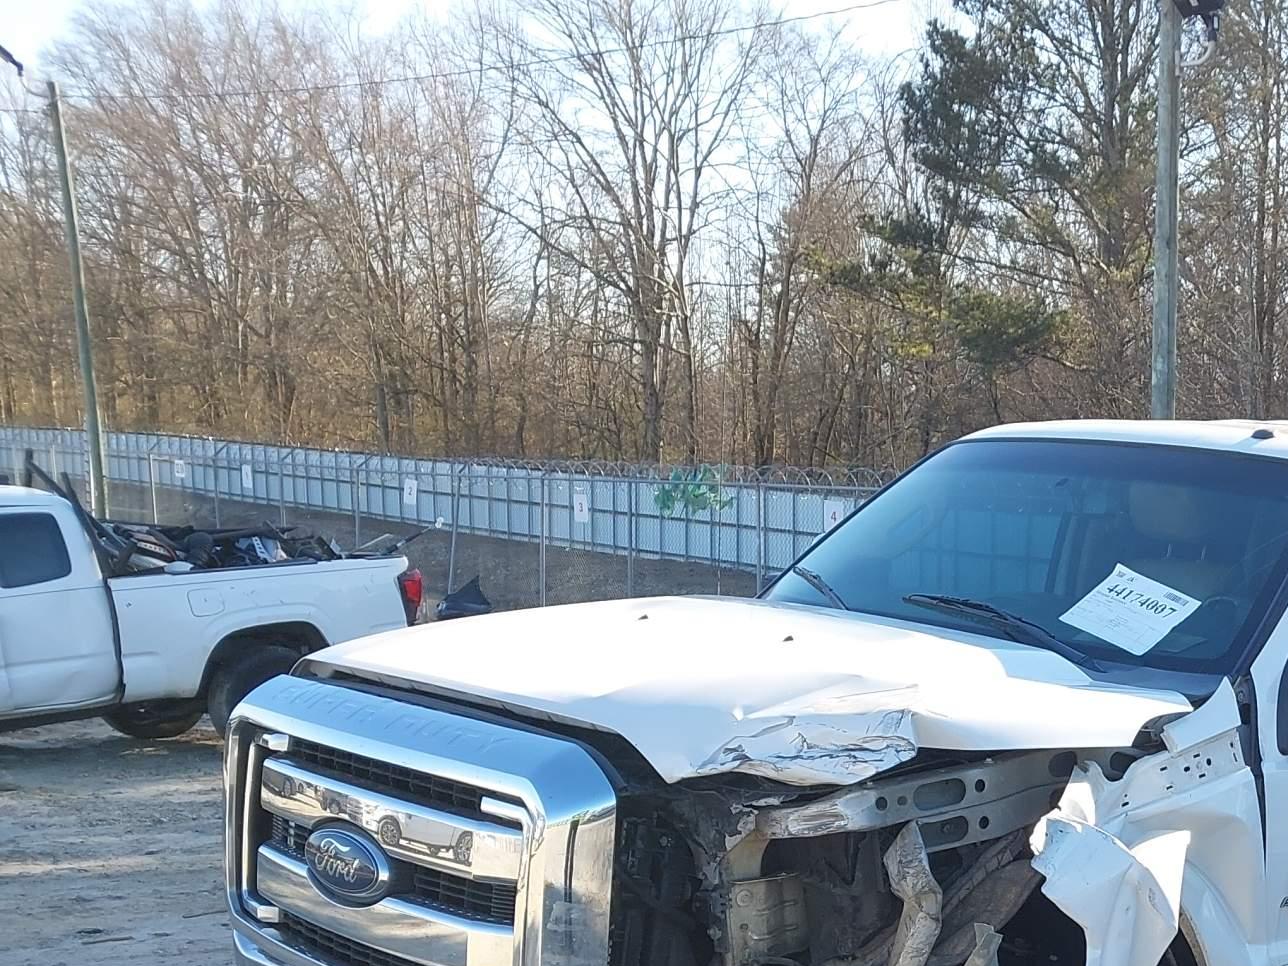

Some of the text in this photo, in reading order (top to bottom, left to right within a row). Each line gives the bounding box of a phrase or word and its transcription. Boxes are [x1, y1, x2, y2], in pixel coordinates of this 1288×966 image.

[408, 486, 413, 496] 2
[578, 502, 584, 512] 3
[830, 511, 837, 523] 4
[1107, 583, 1177, 618] 44174007
[314, 837, 360, 884] Ford
